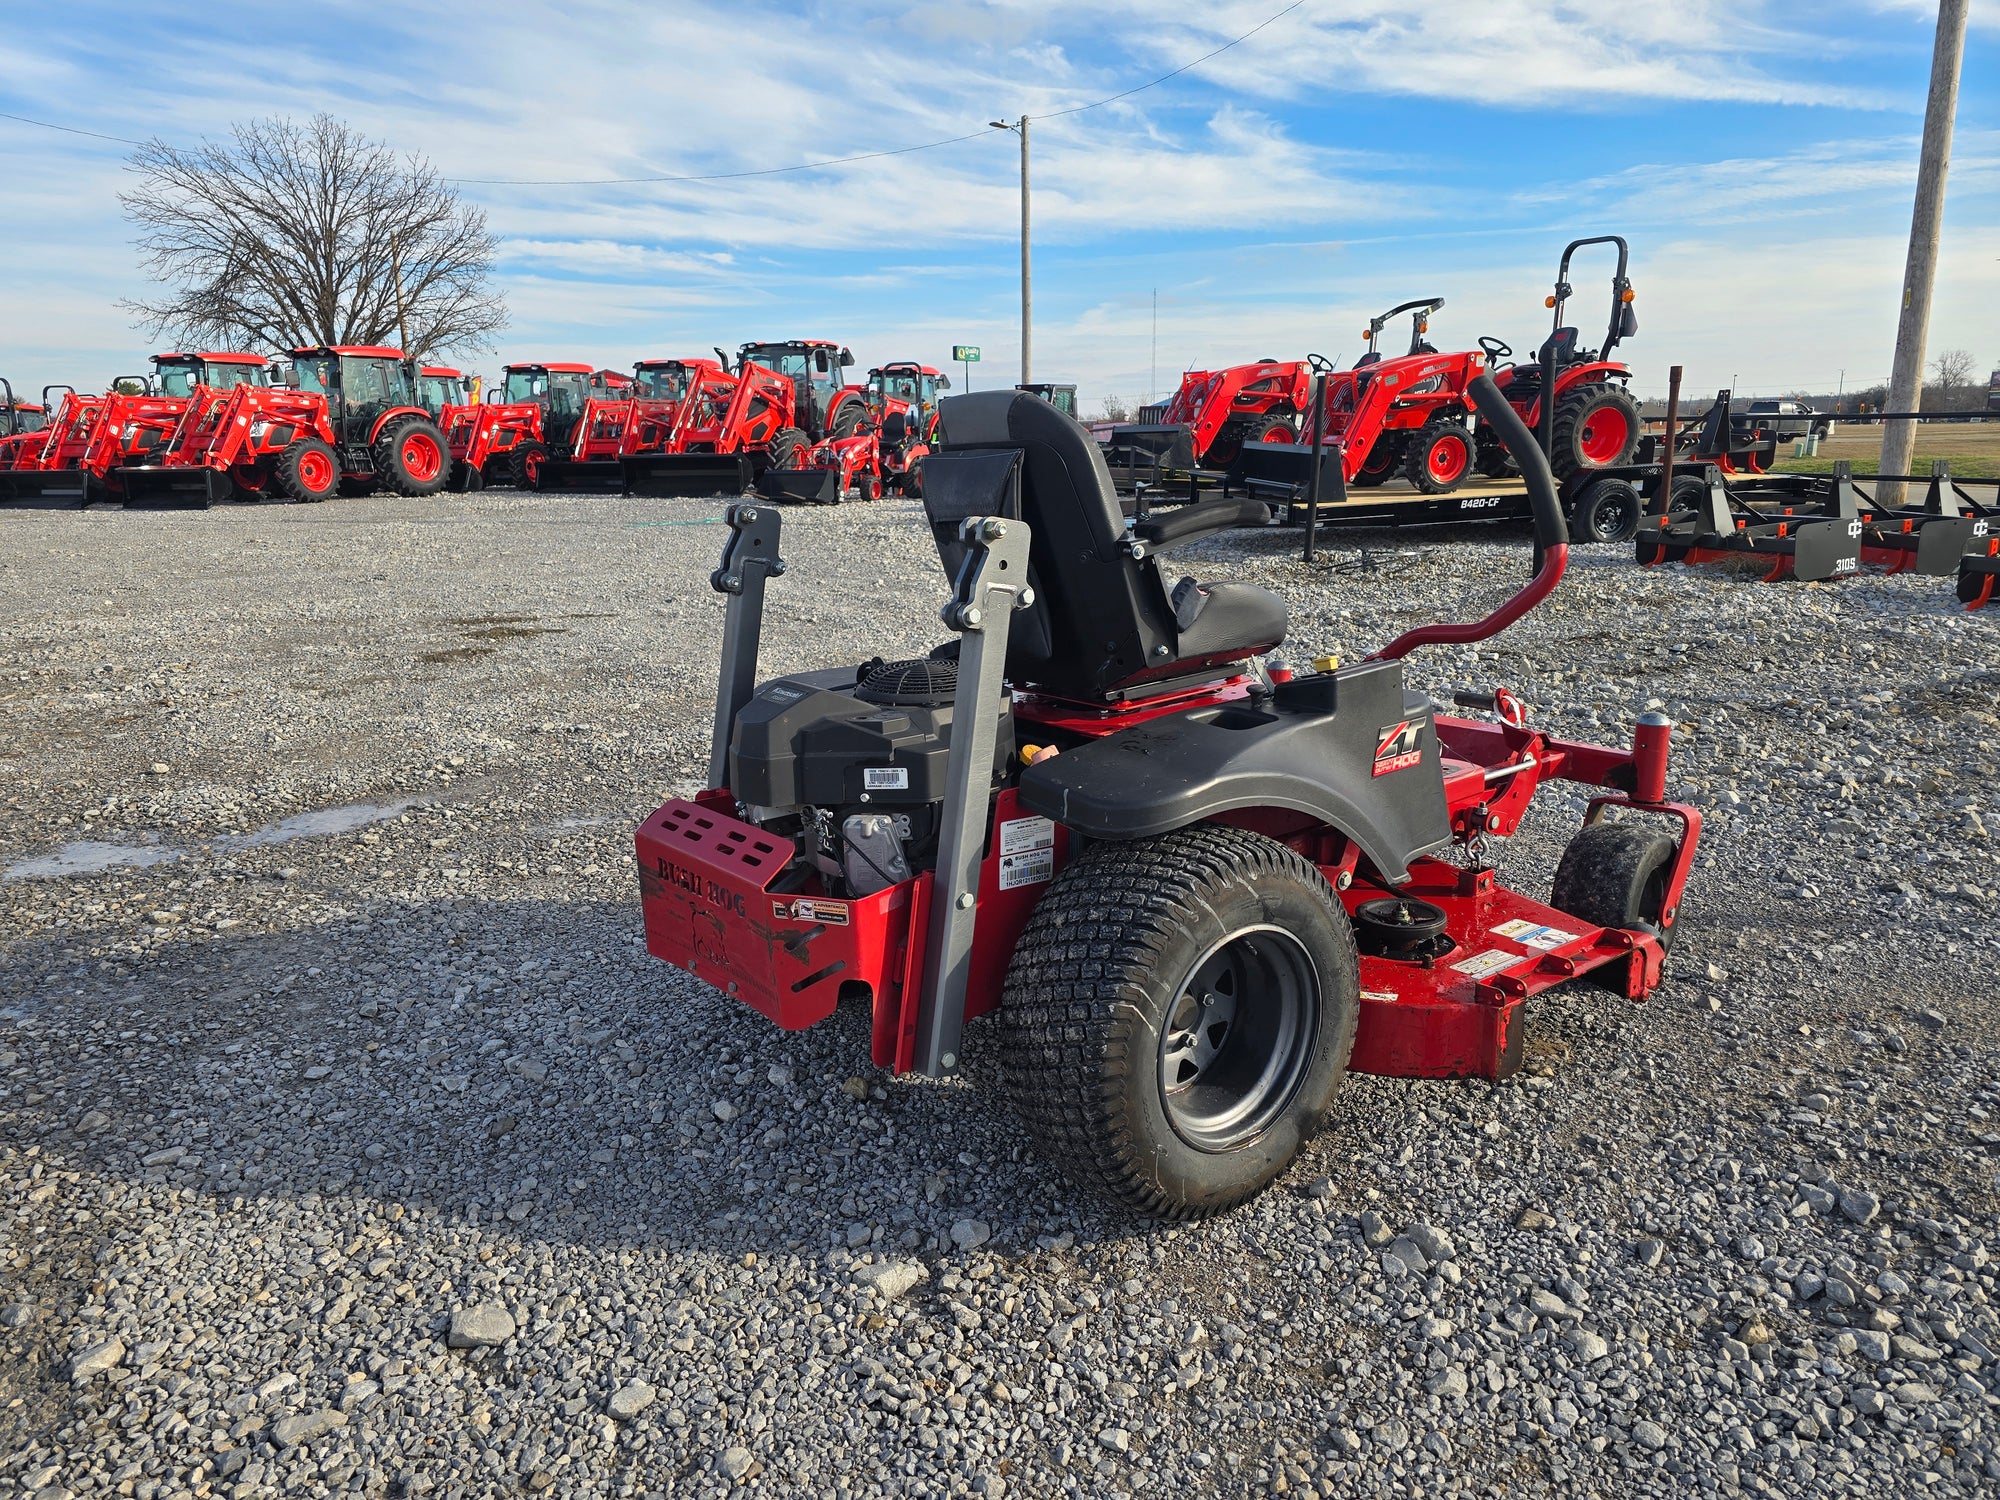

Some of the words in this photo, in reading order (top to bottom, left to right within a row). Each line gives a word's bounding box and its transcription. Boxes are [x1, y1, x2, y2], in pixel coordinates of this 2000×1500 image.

[1461, 498, 1500, 509] 8420-CF
[1374, 715, 1427, 762] ZT
[1392, 751, 1421, 769] HOG
[657, 856, 703, 898] BUSH
[707, 879, 746, 919] HOG
